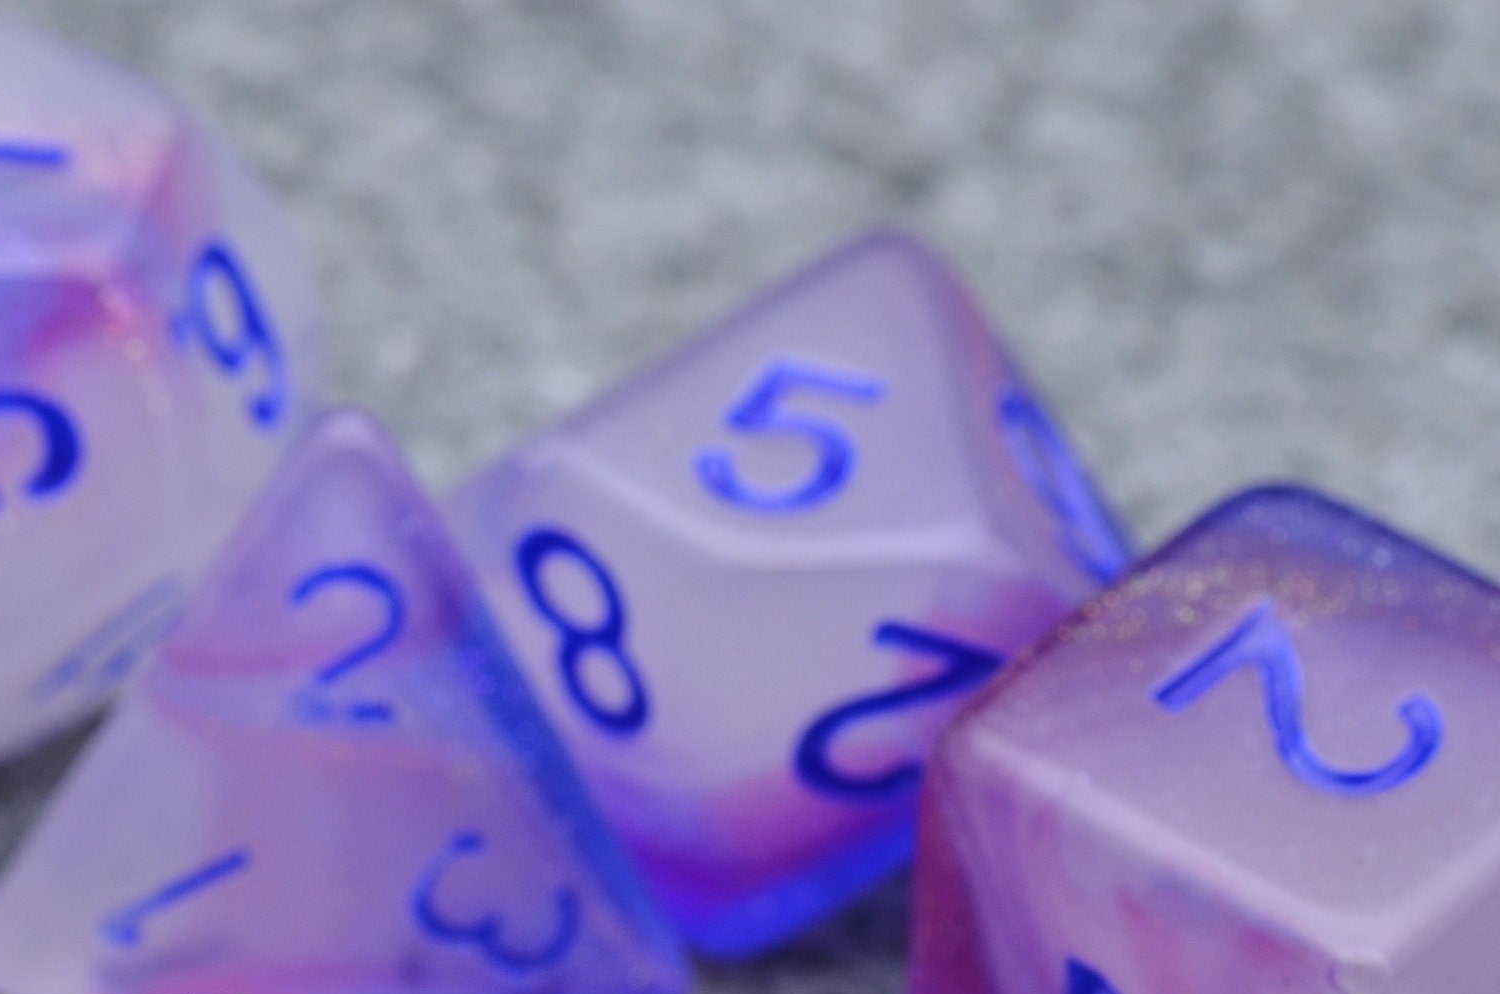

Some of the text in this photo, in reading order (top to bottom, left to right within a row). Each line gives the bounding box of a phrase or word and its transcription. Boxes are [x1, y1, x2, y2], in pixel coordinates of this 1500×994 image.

[690, 357, 888, 514] 5
[289, 561, 405, 725] 2
[515, 526, 651, 738] 8
[792, 618, 1006, 800] 2
[1152, 599, 1446, 797] 2
[104, 847, 252, 946] 1
[409, 829, 581, 974] 3
